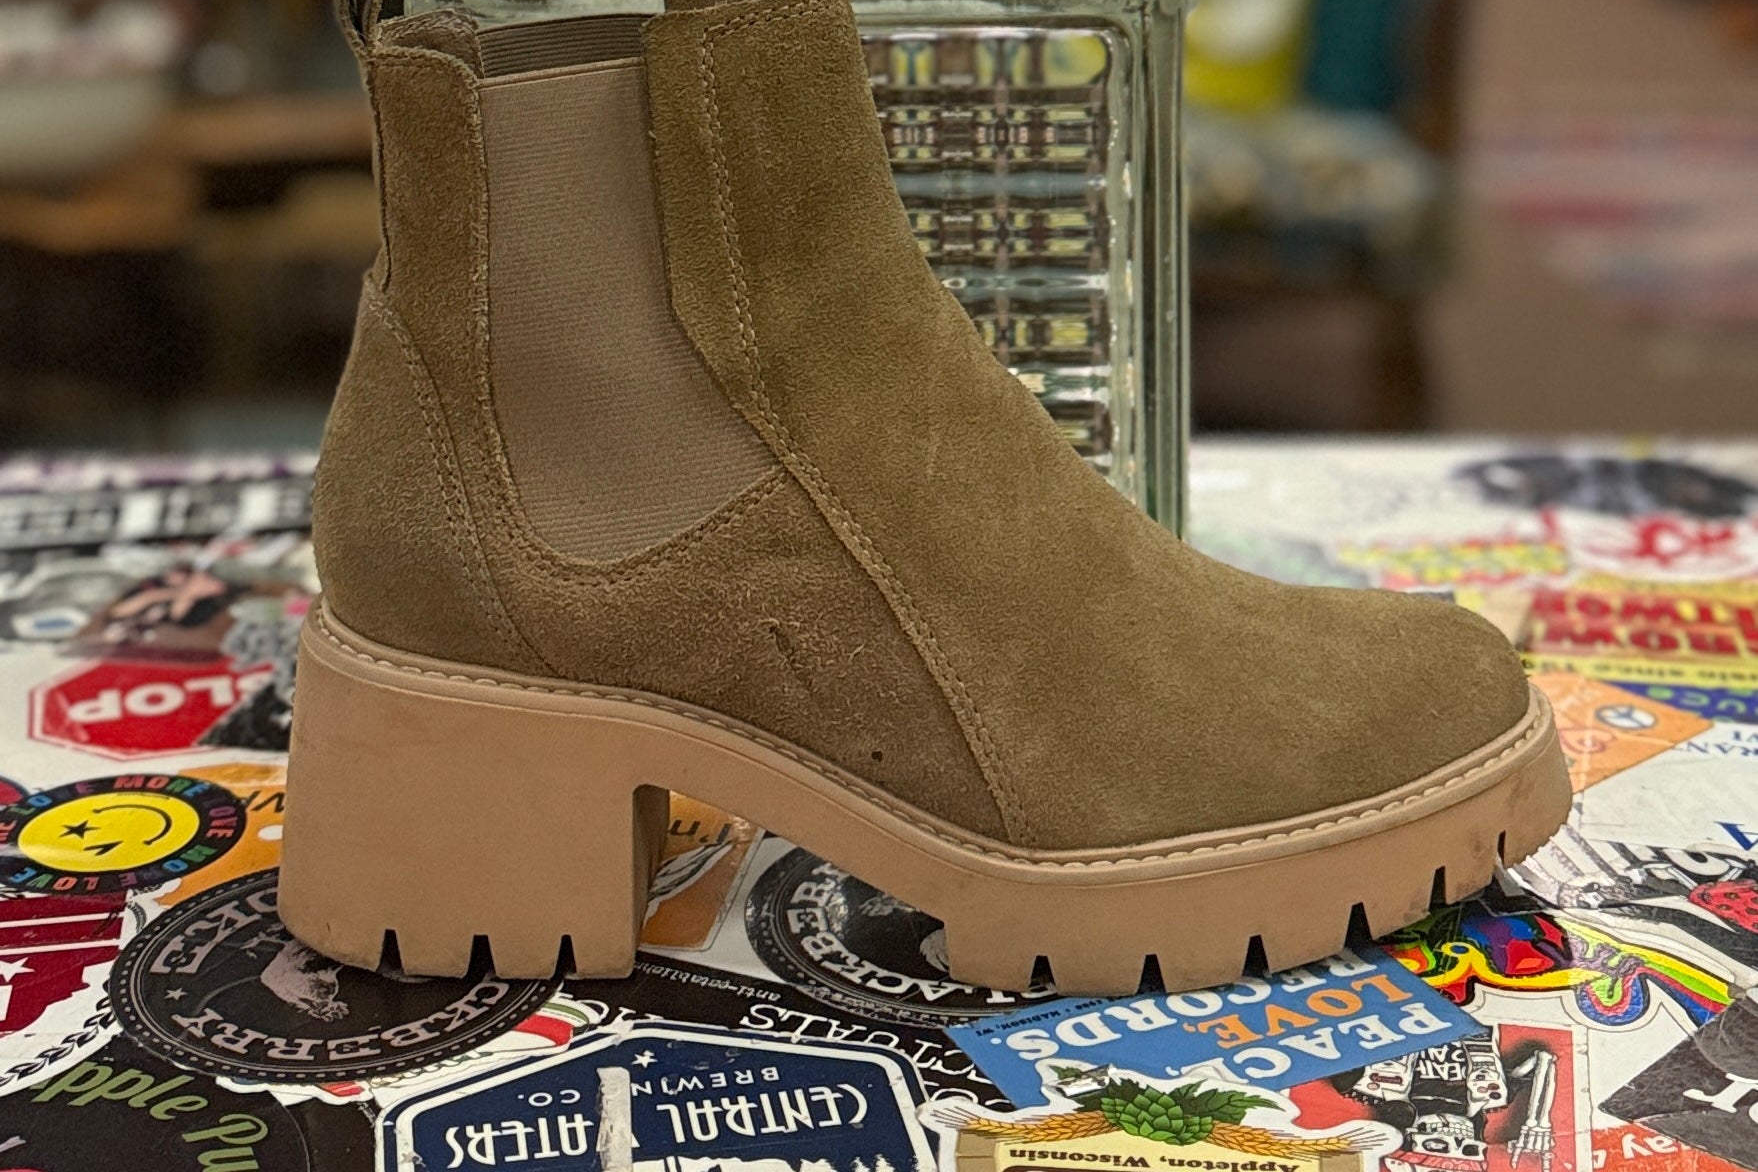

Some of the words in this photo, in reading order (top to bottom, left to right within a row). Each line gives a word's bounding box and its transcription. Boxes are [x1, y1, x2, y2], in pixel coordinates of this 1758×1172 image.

[113, 776, 210, 800] MORE
[10, 866, 100, 892] LOVE
[170, 981, 510, 1061] CKBERRY
[1184, 973, 1413, 1050] LOVE,
[30, 1061, 209, 1121] pple
[517, 1090, 581, 1107] CO.
[631, 1066, 780, 1097] BREWIN
[656, 1083, 868, 1145] CENTRAL
[183, 1114, 269, 1172] Pu
[446, 1112, 640, 1170] ATERS
[1008, 1149, 1151, 1168] Wisconsin
[1159, 1156, 1300, 1172] Appleton,
